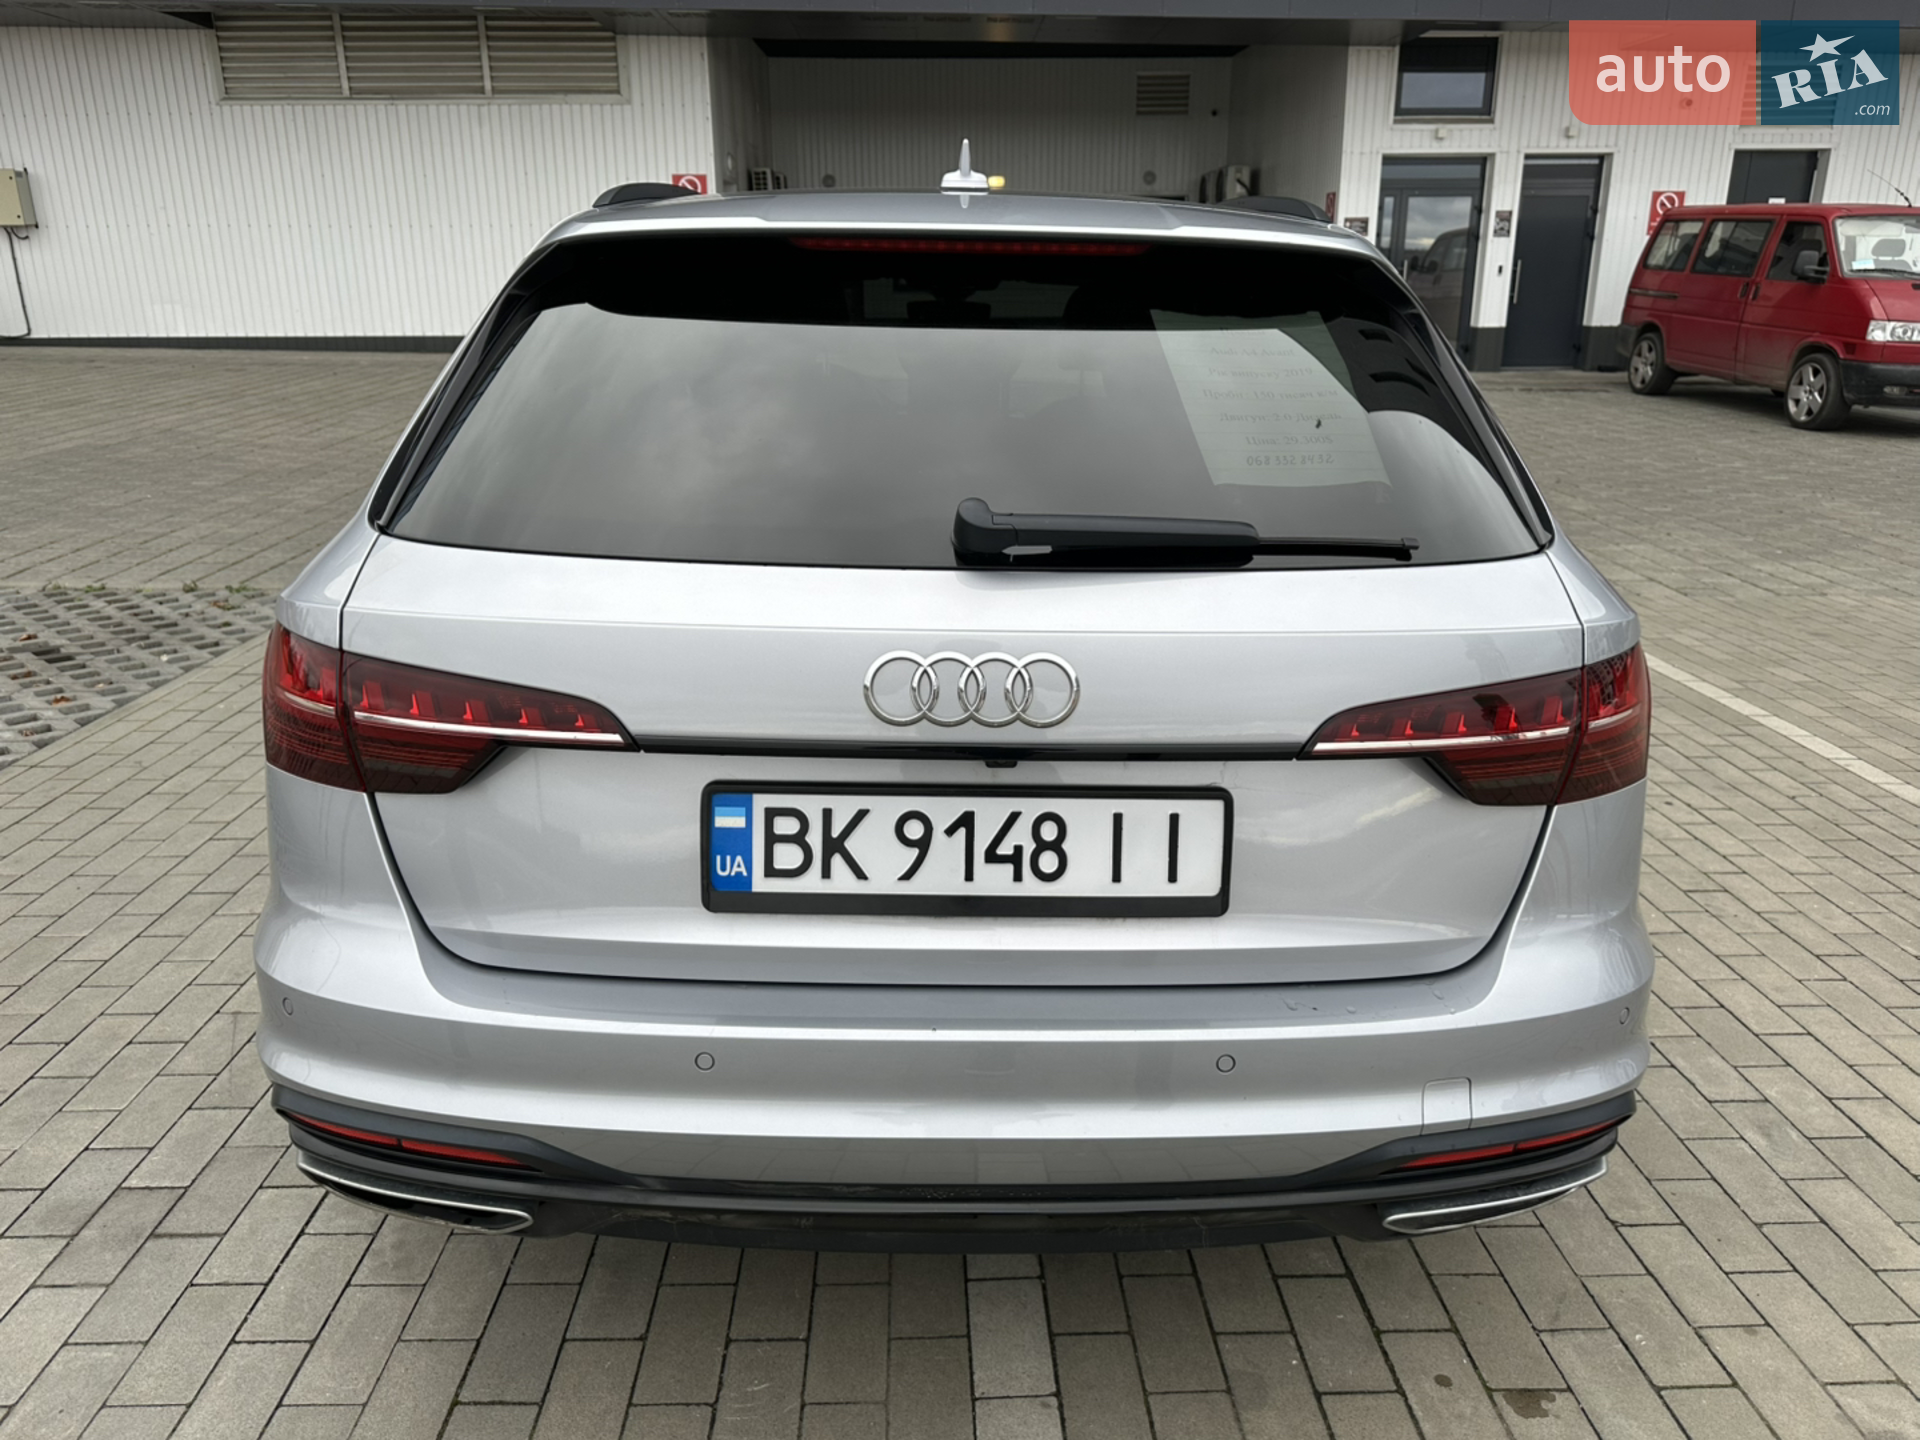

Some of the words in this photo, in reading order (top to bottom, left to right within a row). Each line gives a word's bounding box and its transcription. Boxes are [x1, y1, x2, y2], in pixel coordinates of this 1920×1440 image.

[1210, 347, 1238, 356] Audi
[1241, 348, 1258, 356] A4
[1260, 348, 1295, 357] Avant
[1283, 367, 1313, 377] 2019
[1245, 435, 1280, 446] Ціна:
[1246, 455, 1271, 466] 068
[1274, 454, 1298, 466] 332
[763, 806, 871, 880] BK
[893, 809, 1068, 883] 9148
[715, 856, 748, 877] UA
